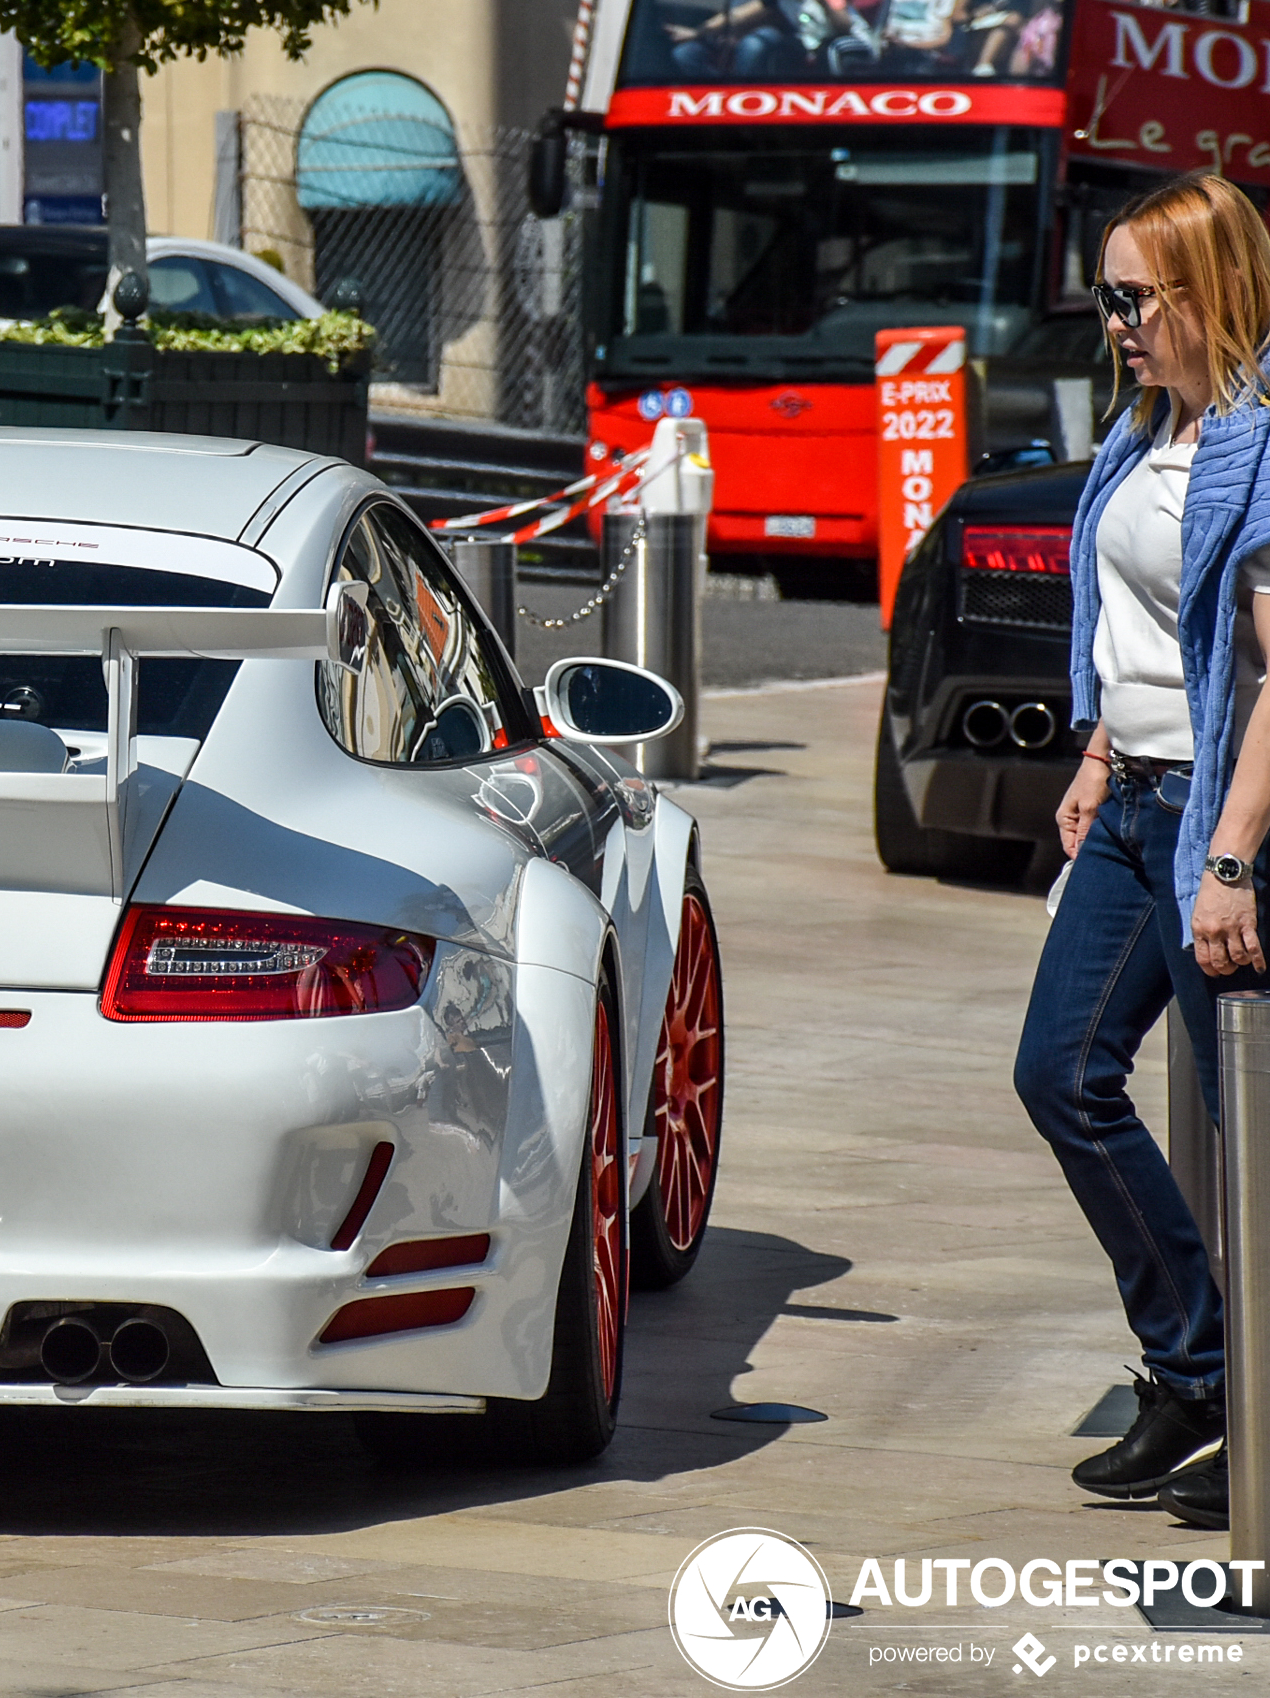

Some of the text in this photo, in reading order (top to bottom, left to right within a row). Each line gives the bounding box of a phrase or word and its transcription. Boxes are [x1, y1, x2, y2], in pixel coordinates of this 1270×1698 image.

[667, 90, 972, 117] MONACO
[1088, 74, 1173, 153] Le
[881, 380, 953, 406] E-PRIX
[882, 409, 955, 441] 2022
